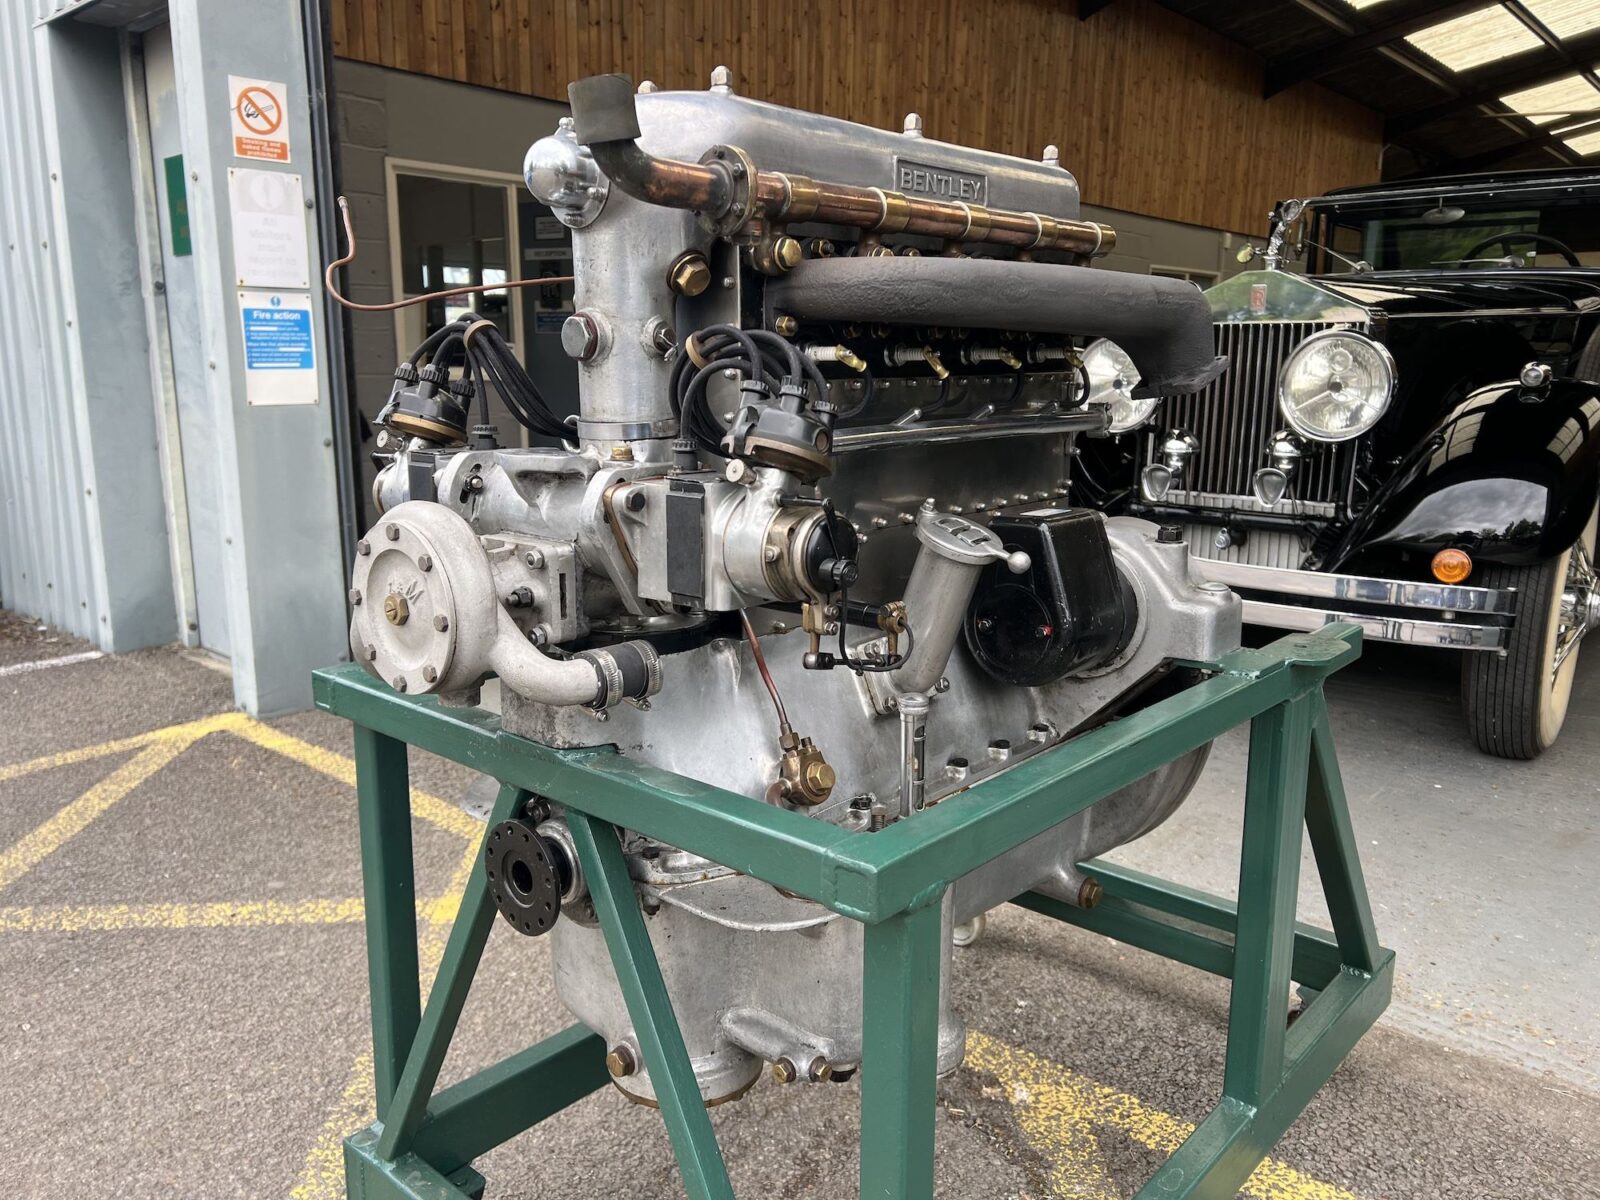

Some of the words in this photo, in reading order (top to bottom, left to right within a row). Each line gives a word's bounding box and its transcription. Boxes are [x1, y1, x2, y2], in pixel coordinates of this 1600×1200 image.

[900, 167, 981, 201] BENTLEY
[253, 310, 271, 320] Fire
[273, 311, 301, 320] action
